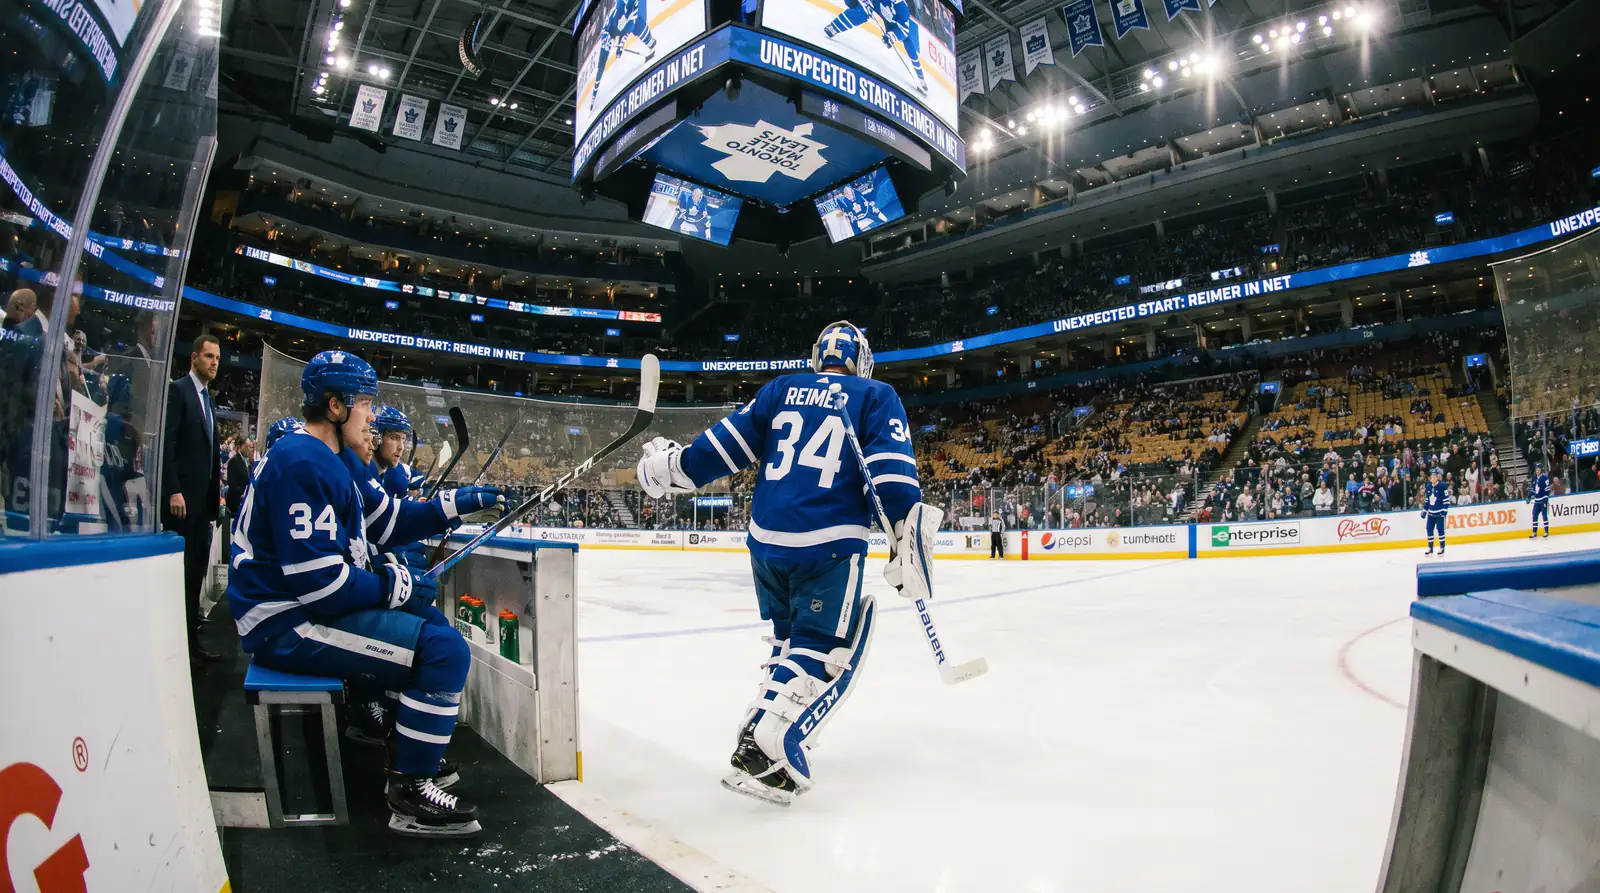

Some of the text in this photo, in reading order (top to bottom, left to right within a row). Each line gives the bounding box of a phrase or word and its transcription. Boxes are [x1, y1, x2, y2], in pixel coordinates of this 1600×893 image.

[602, 99, 628, 139] START:
[628, 75, 665, 115] REIMER
[667, 59, 679, 88] IN
[681, 44, 706, 79] NET
[760, 38, 856, 95] UNEXPECTED
[859, 77, 900, 117] START:
[901, 99, 936, 142] REIMER
[936, 124, 945, 148] IN
[945, 131, 958, 160] NET
[726, 141, 801, 171] TORONTO
[90, 242, 105, 258] NET
[1053, 306, 1135, 333] UNEXPECTED
[1138, 296, 1185, 316] START:
[1188, 286, 1241, 307] REIMER
[1245, 281, 1260, 297] IN
[1263, 275, 1292, 293] NET
[348, 328, 526, 361] UNEXPECTED START: REIMER IN NET
[702, 361, 768, 371] UNEXPECTED
[770, 360, 805, 370] START:
[889, 418, 912, 443] 3
[765, 410, 848, 489] 34
[289, 503, 338, 541] 34
[1551, 503, 1600, 518] Warmup
[1058, 534, 1092, 549] pepsi
[1213, 526, 1299, 542] enterprise
[799, 686, 839, 735] CCM
